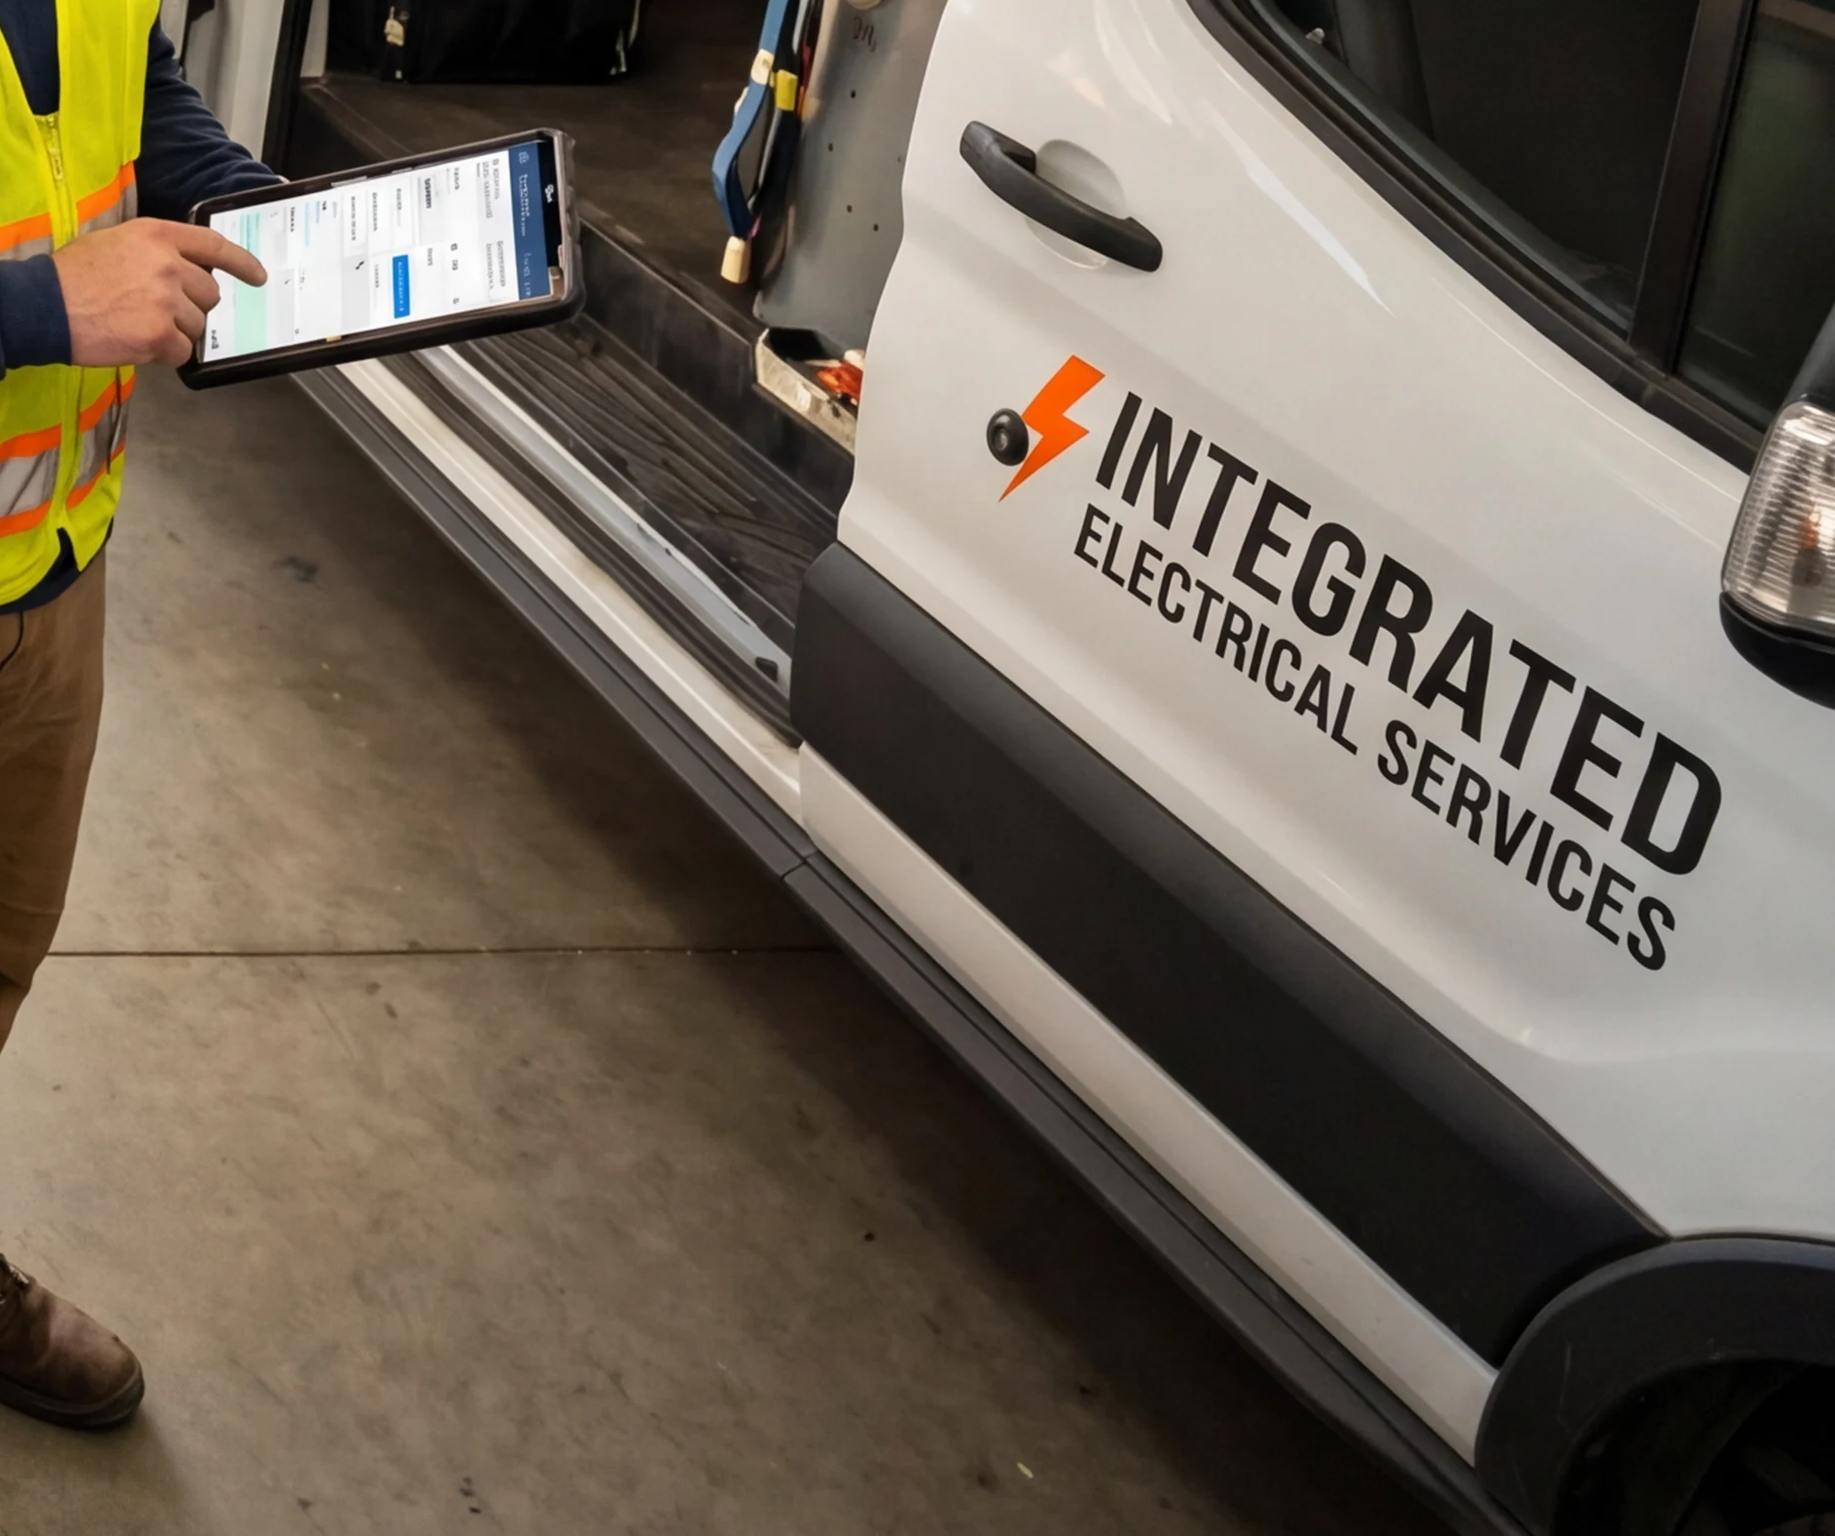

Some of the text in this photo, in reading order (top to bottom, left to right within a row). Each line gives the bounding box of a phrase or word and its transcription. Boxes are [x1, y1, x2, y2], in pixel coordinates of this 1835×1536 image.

[1071, 501, 1677, 972] ELECTRICAL SERVICES
[1094, 390, 1723, 877] INTEGRATED
